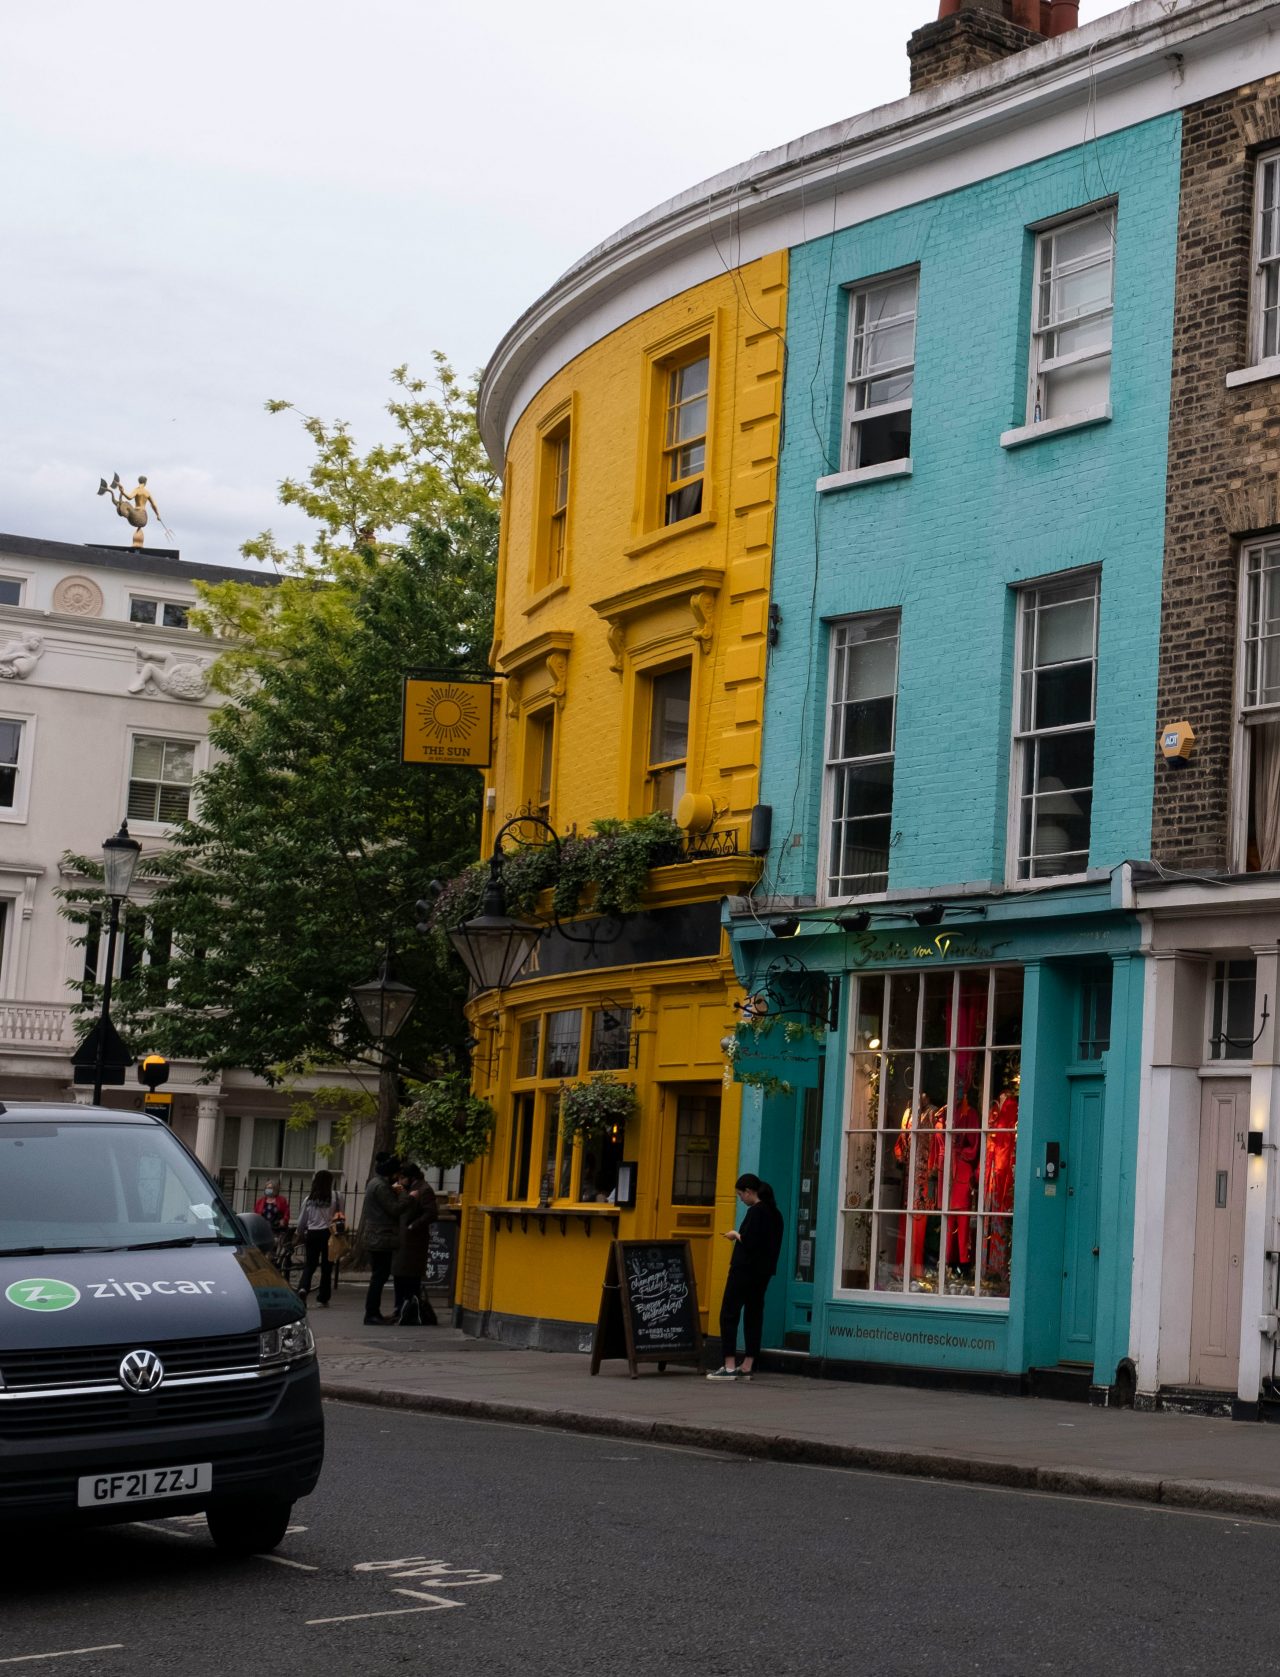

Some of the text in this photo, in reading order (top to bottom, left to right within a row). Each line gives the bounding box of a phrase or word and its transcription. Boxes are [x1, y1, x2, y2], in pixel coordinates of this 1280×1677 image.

[1165, 734, 1178, 746] ADT
[422, 745, 471, 758] THE SUN
[912, 945, 934, 959] von
[86, 1277, 216, 1301] zipcar
[829, 1325, 997, 1351] www.beatricevontresckow.com
[93, 1467, 199, 1500] GF21 ZZJ
